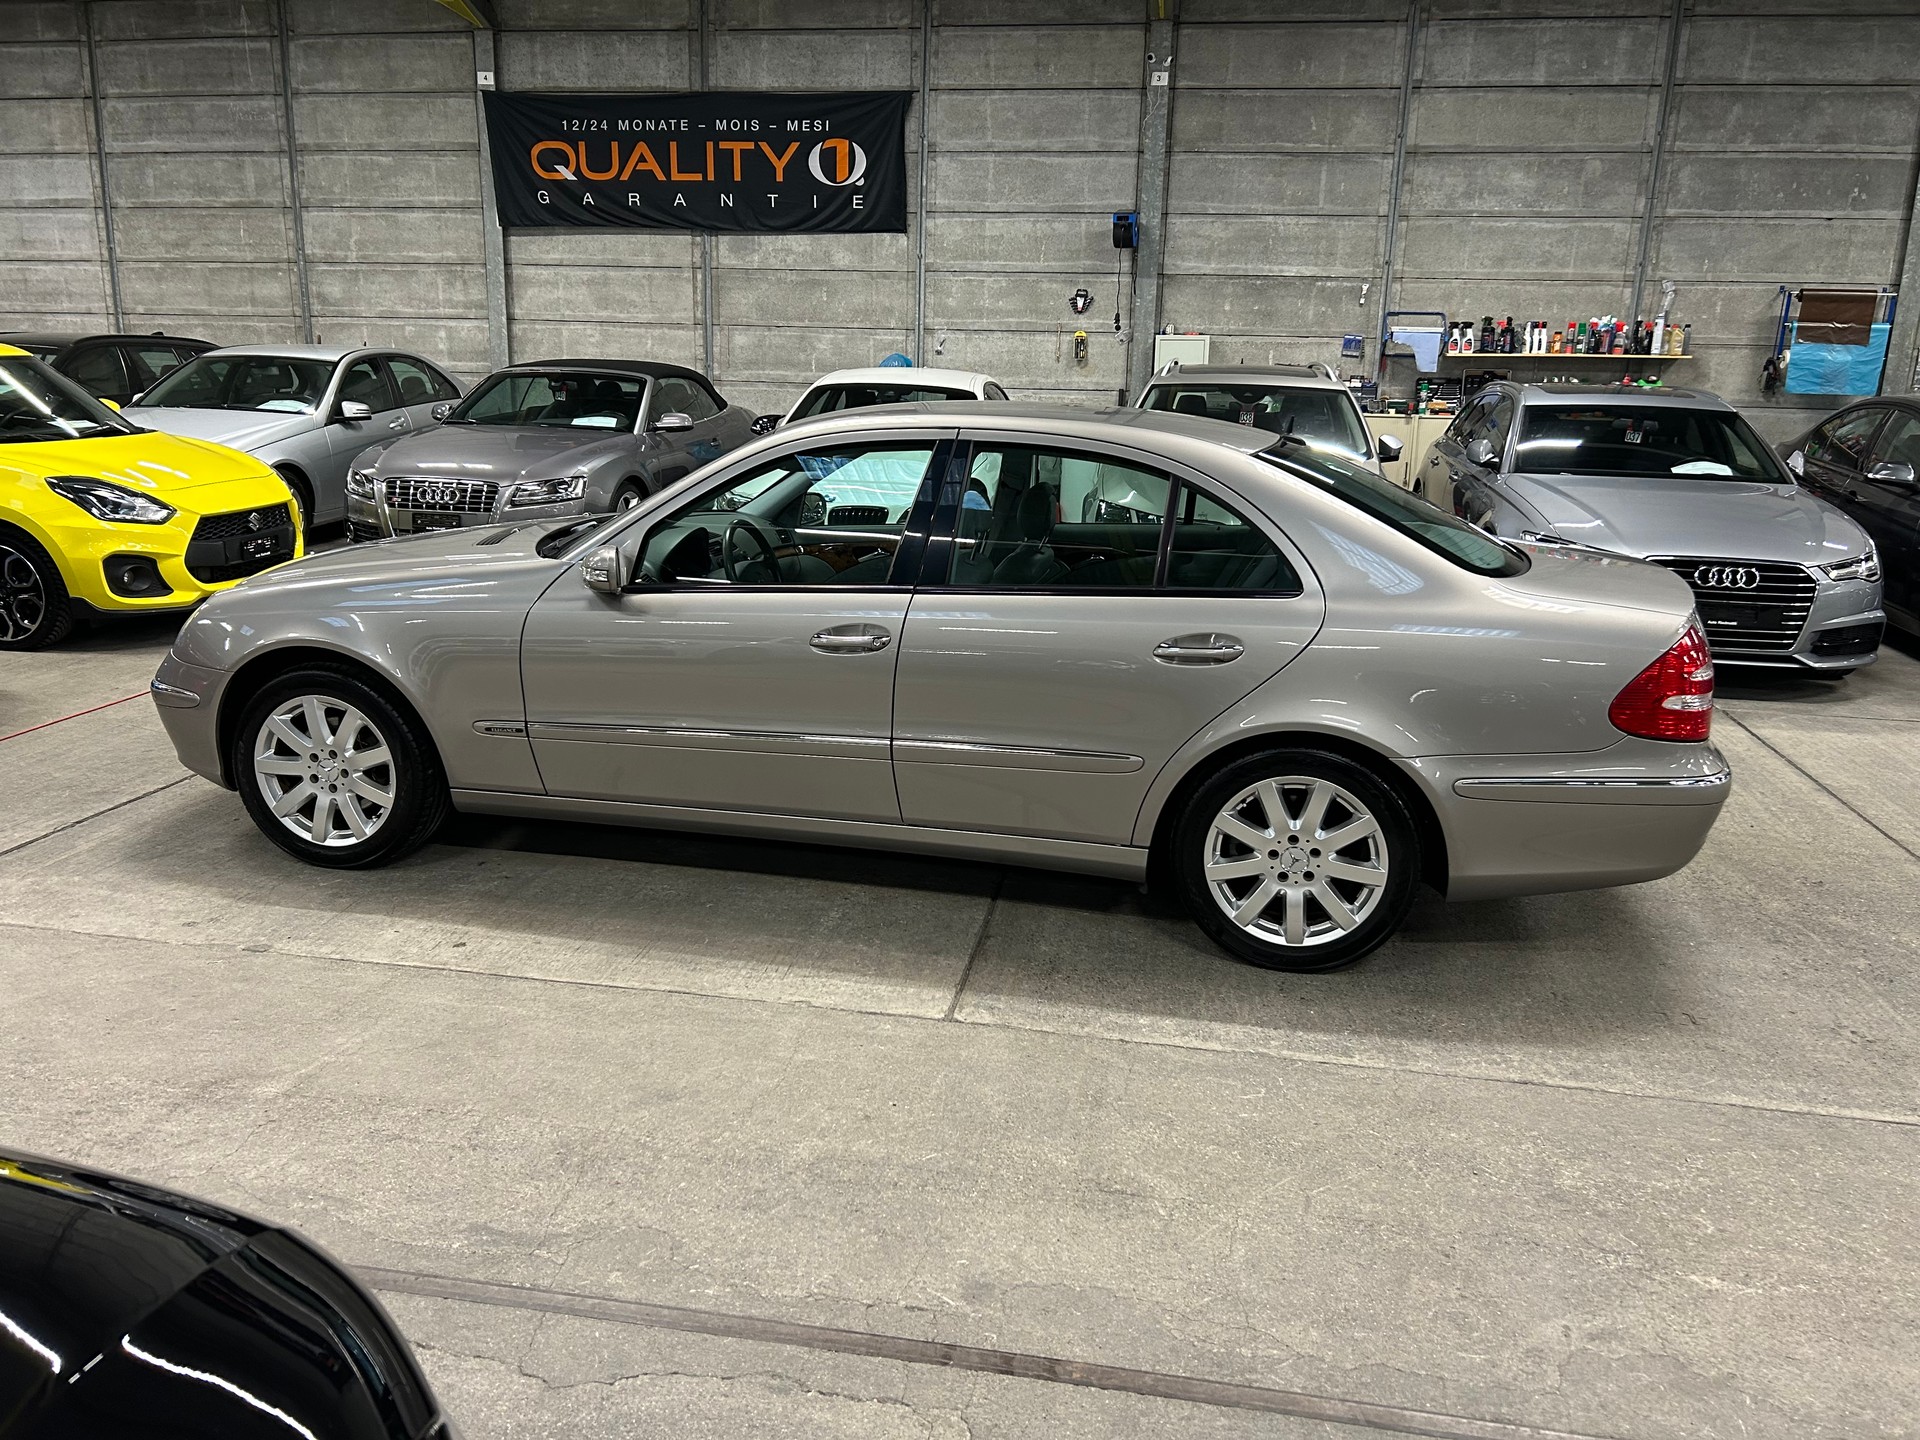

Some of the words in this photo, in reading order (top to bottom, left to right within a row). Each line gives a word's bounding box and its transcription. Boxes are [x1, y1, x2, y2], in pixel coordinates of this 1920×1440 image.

[561, 119, 608, 131] 12/24
[618, 119, 689, 131] MONATE
[715, 119, 760, 131] MOIS
[787, 120, 829, 132] MESI
[530, 140, 801, 183] QUALITY
[537, 190, 864, 209] GARANTIE
